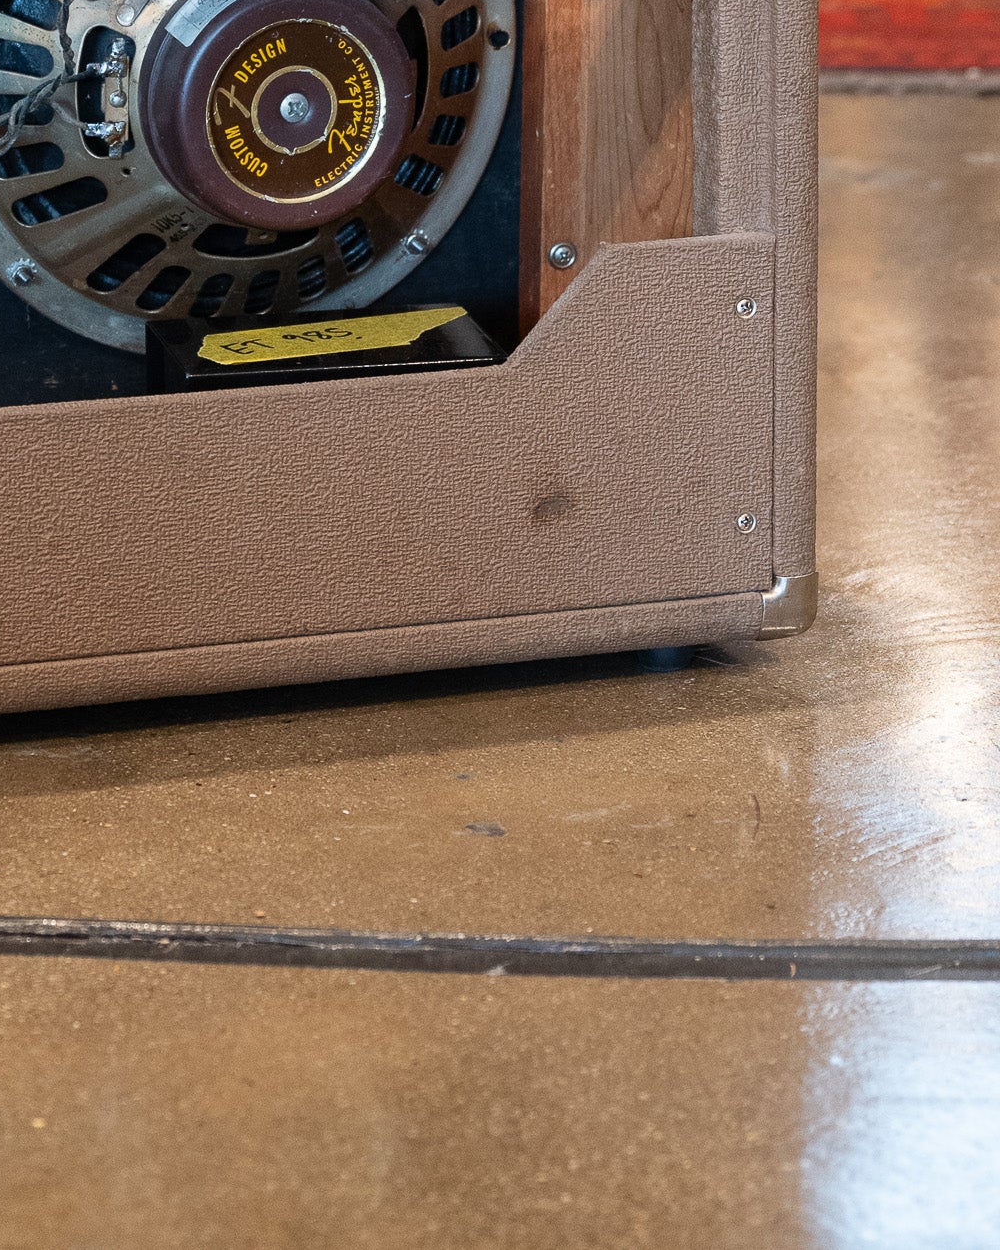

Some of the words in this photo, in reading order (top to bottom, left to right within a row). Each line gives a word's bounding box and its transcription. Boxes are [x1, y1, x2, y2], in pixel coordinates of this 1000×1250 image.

[233, 37, 287, 84] DESIGN
[337, 37, 353, 56] CO.
[327, 74, 364, 154] Fender
[351, 56, 375, 139] INSTRUMENT
[224, 125, 269, 178] CUSTOM
[314, 144, 364, 188] ELECTRIC
[219, 338, 275, 355] ET
